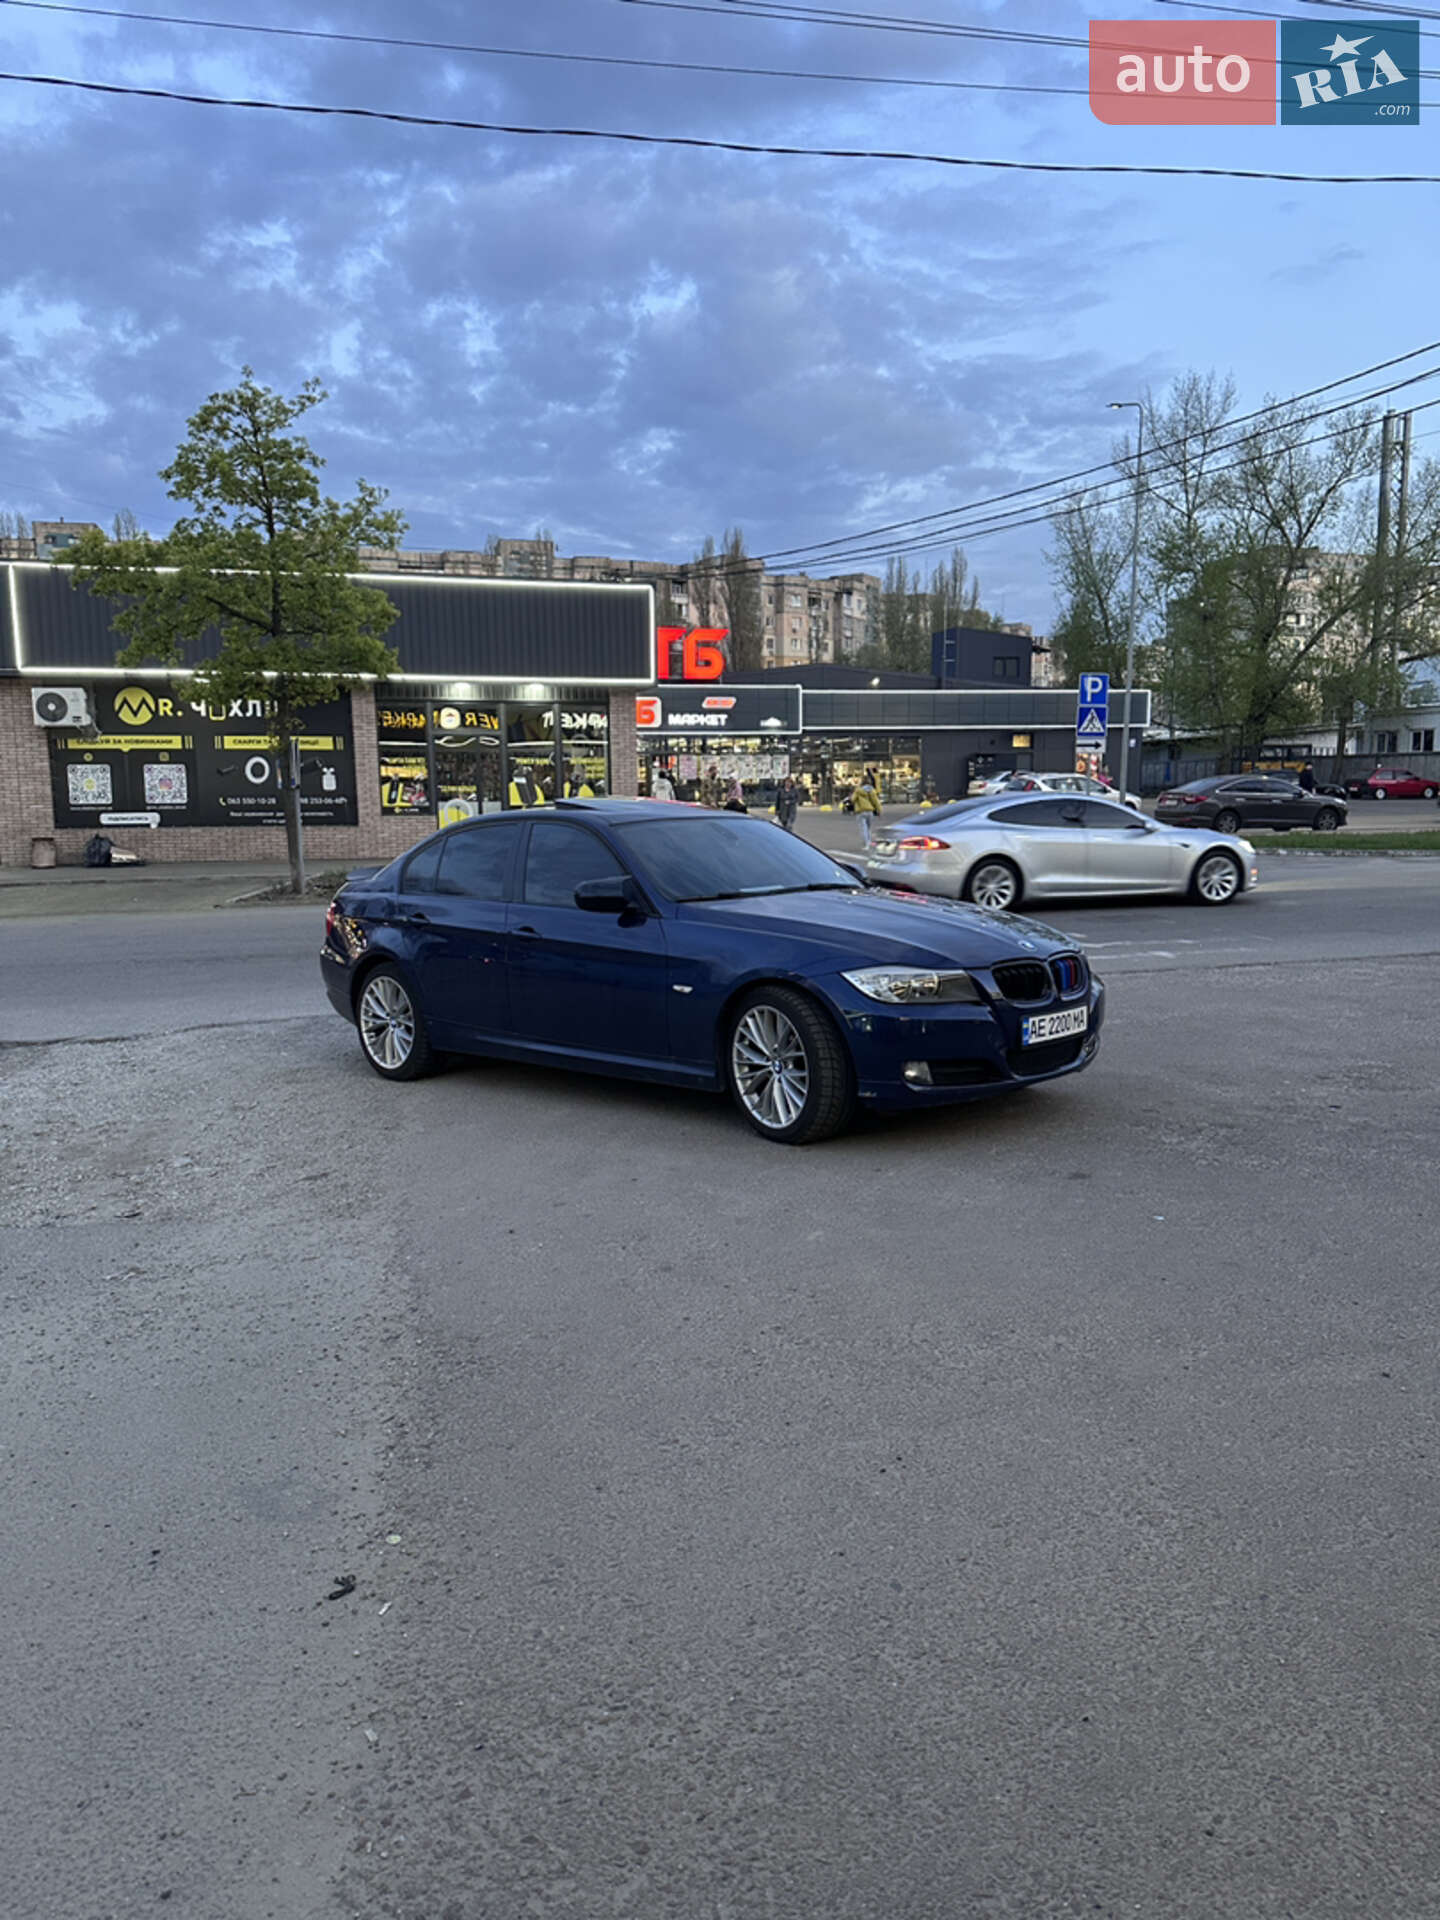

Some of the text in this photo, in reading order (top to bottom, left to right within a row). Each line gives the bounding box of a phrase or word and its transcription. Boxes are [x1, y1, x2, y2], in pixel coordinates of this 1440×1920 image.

[1085, 677, 1103, 702] P
[1030, 1019, 1046, 1038] AE
[1048, 1013, 1071, 1036] 2200
